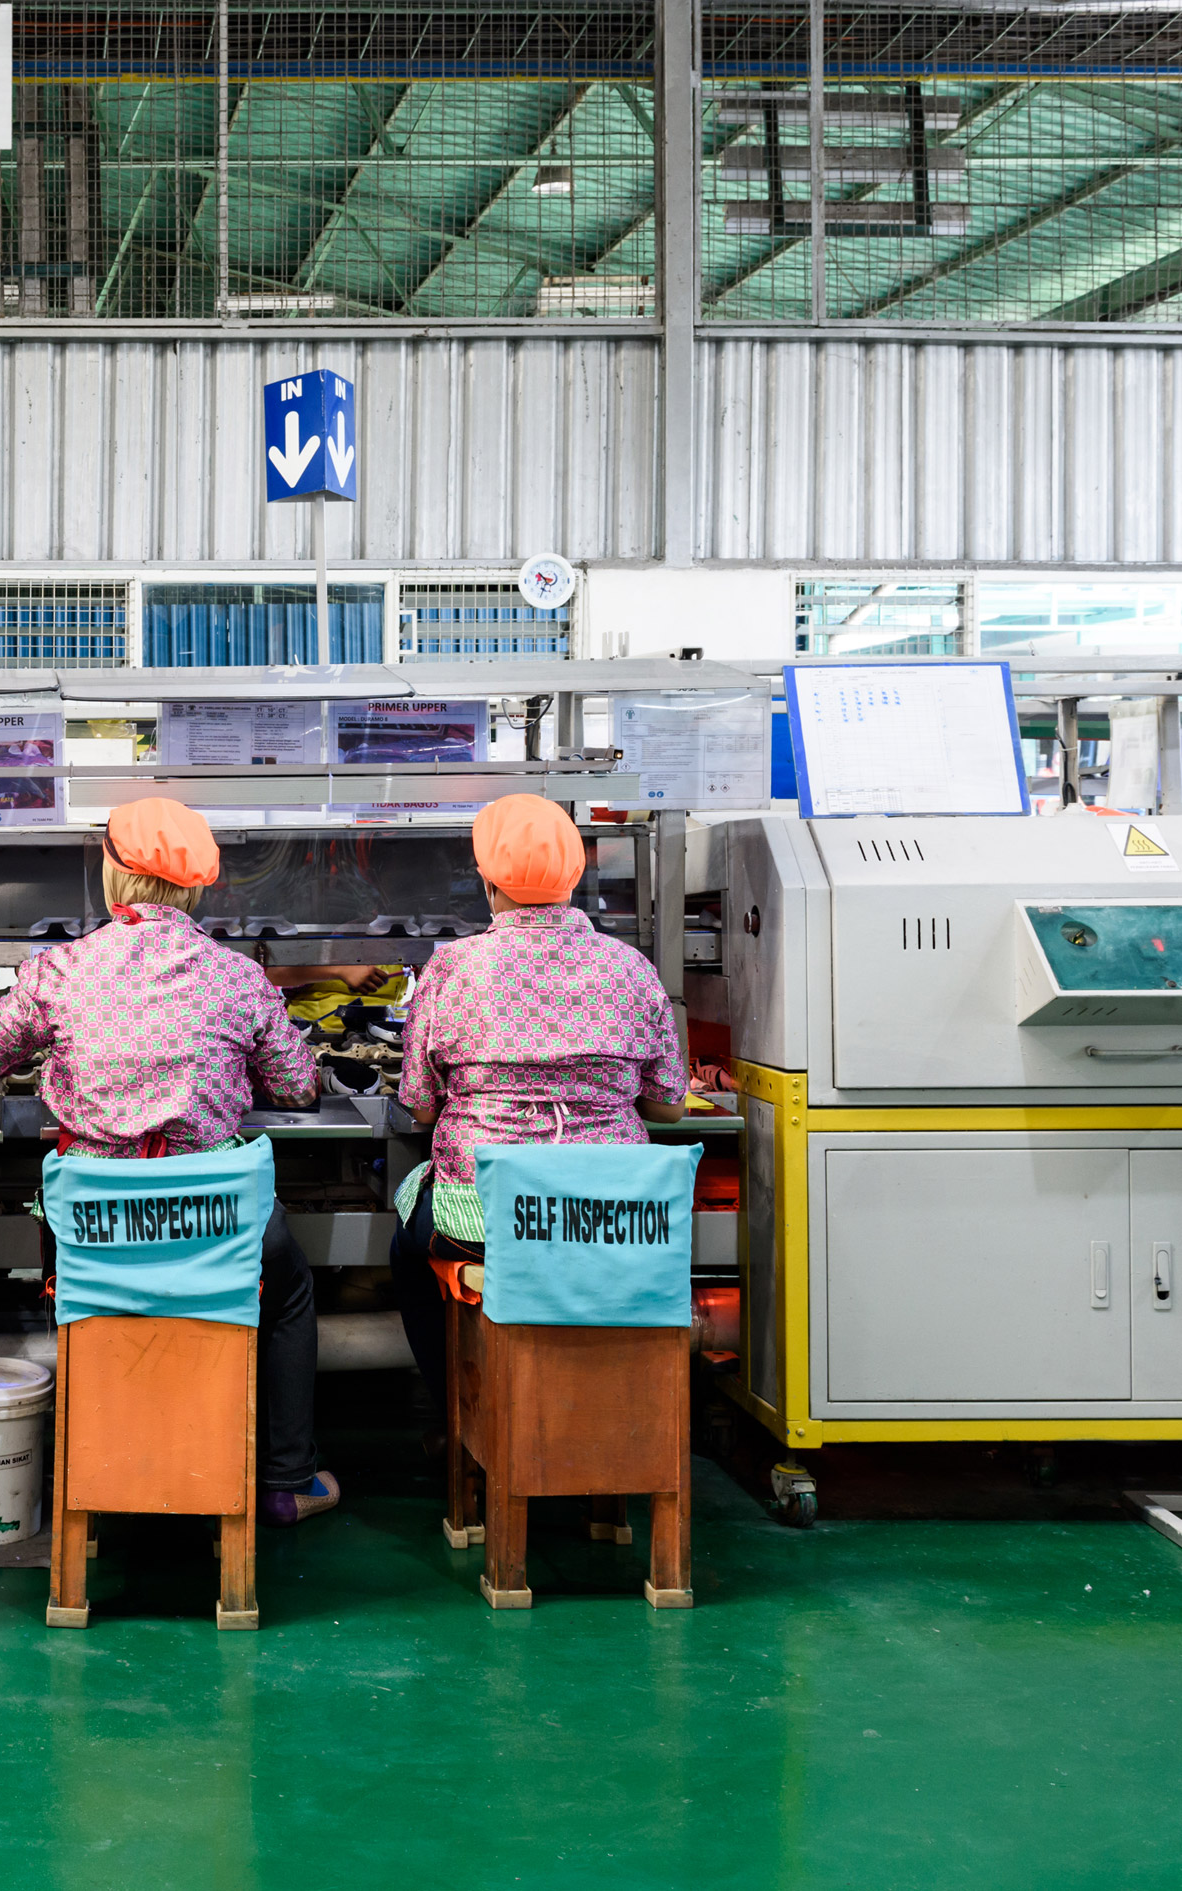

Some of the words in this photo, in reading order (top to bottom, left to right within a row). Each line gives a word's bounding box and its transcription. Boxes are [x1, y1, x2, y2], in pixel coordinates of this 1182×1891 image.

[281, 378, 303, 402] IN
[335, 377, 346, 401] IN
[368, 702, 410, 712] PRIMER
[412, 702, 447, 712] UPPER
[73, 1199, 120, 1243] SELF
[124, 1193, 239, 1242] INSPECTION
[513, 1194, 557, 1241] SELF
[562, 1197, 670, 1245] INSPECTION
[12, 1454, 30, 1464] SIKAT
